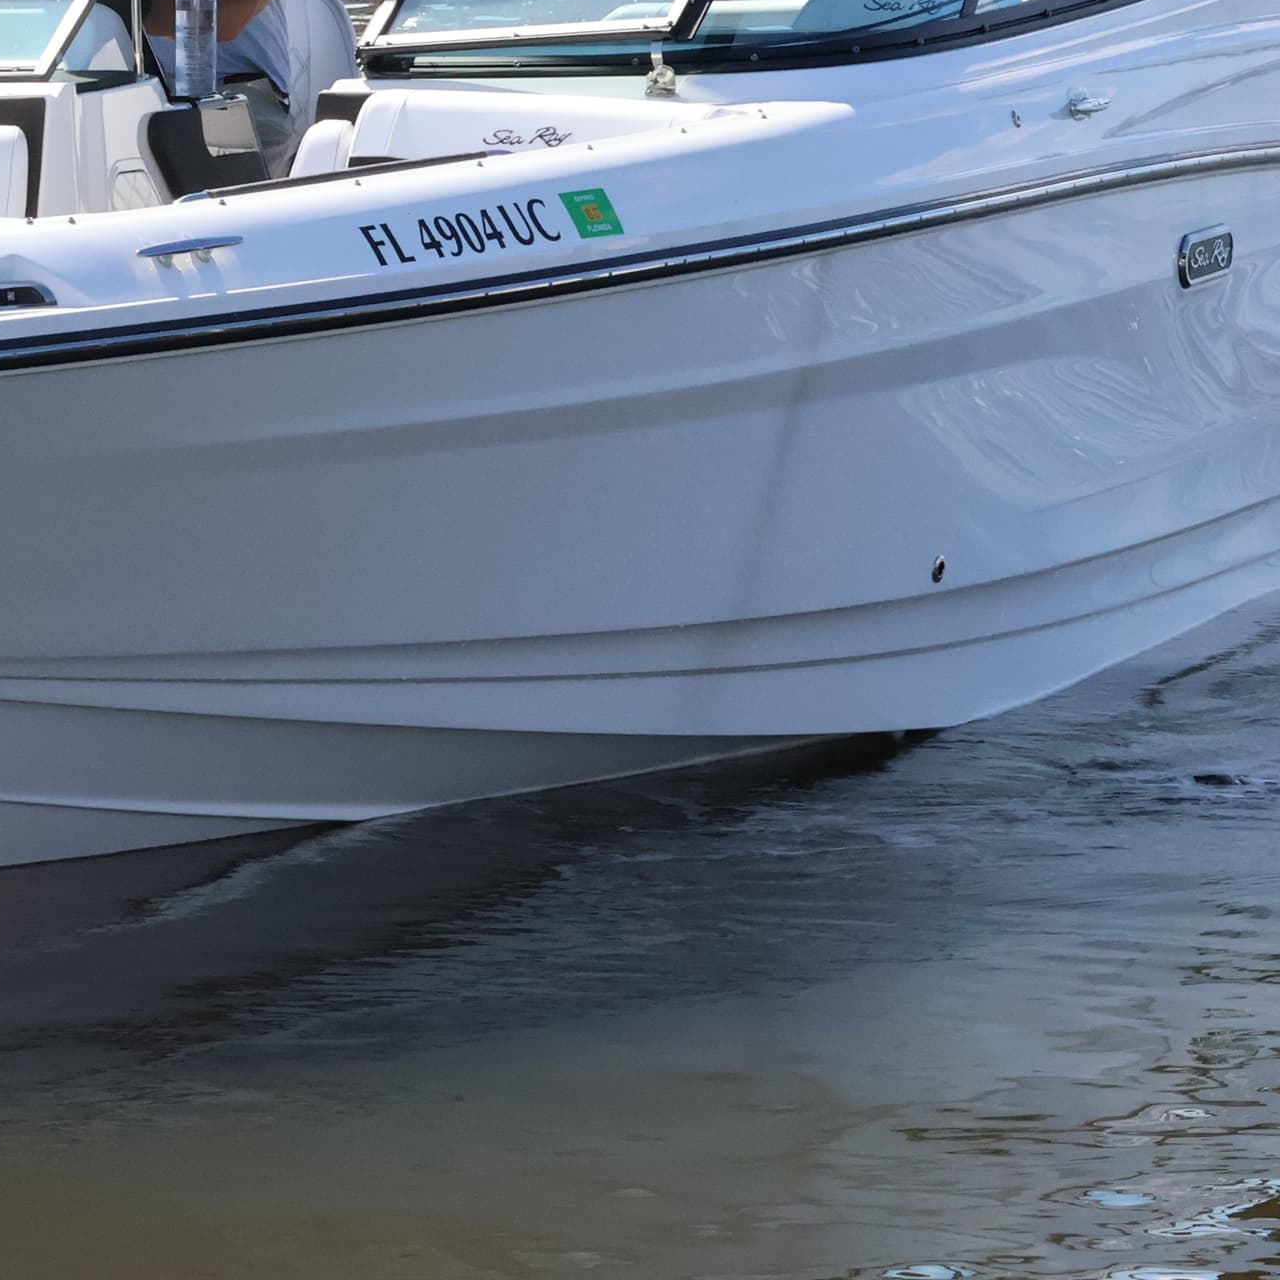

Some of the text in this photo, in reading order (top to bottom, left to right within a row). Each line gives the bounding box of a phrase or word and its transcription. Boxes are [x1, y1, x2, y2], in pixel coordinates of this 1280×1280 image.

[483, 126, 573, 148] Sea Ray
[359, 198, 561, 266] FL 4904 UC
[1190, 239, 1231, 268] Sea Ray
